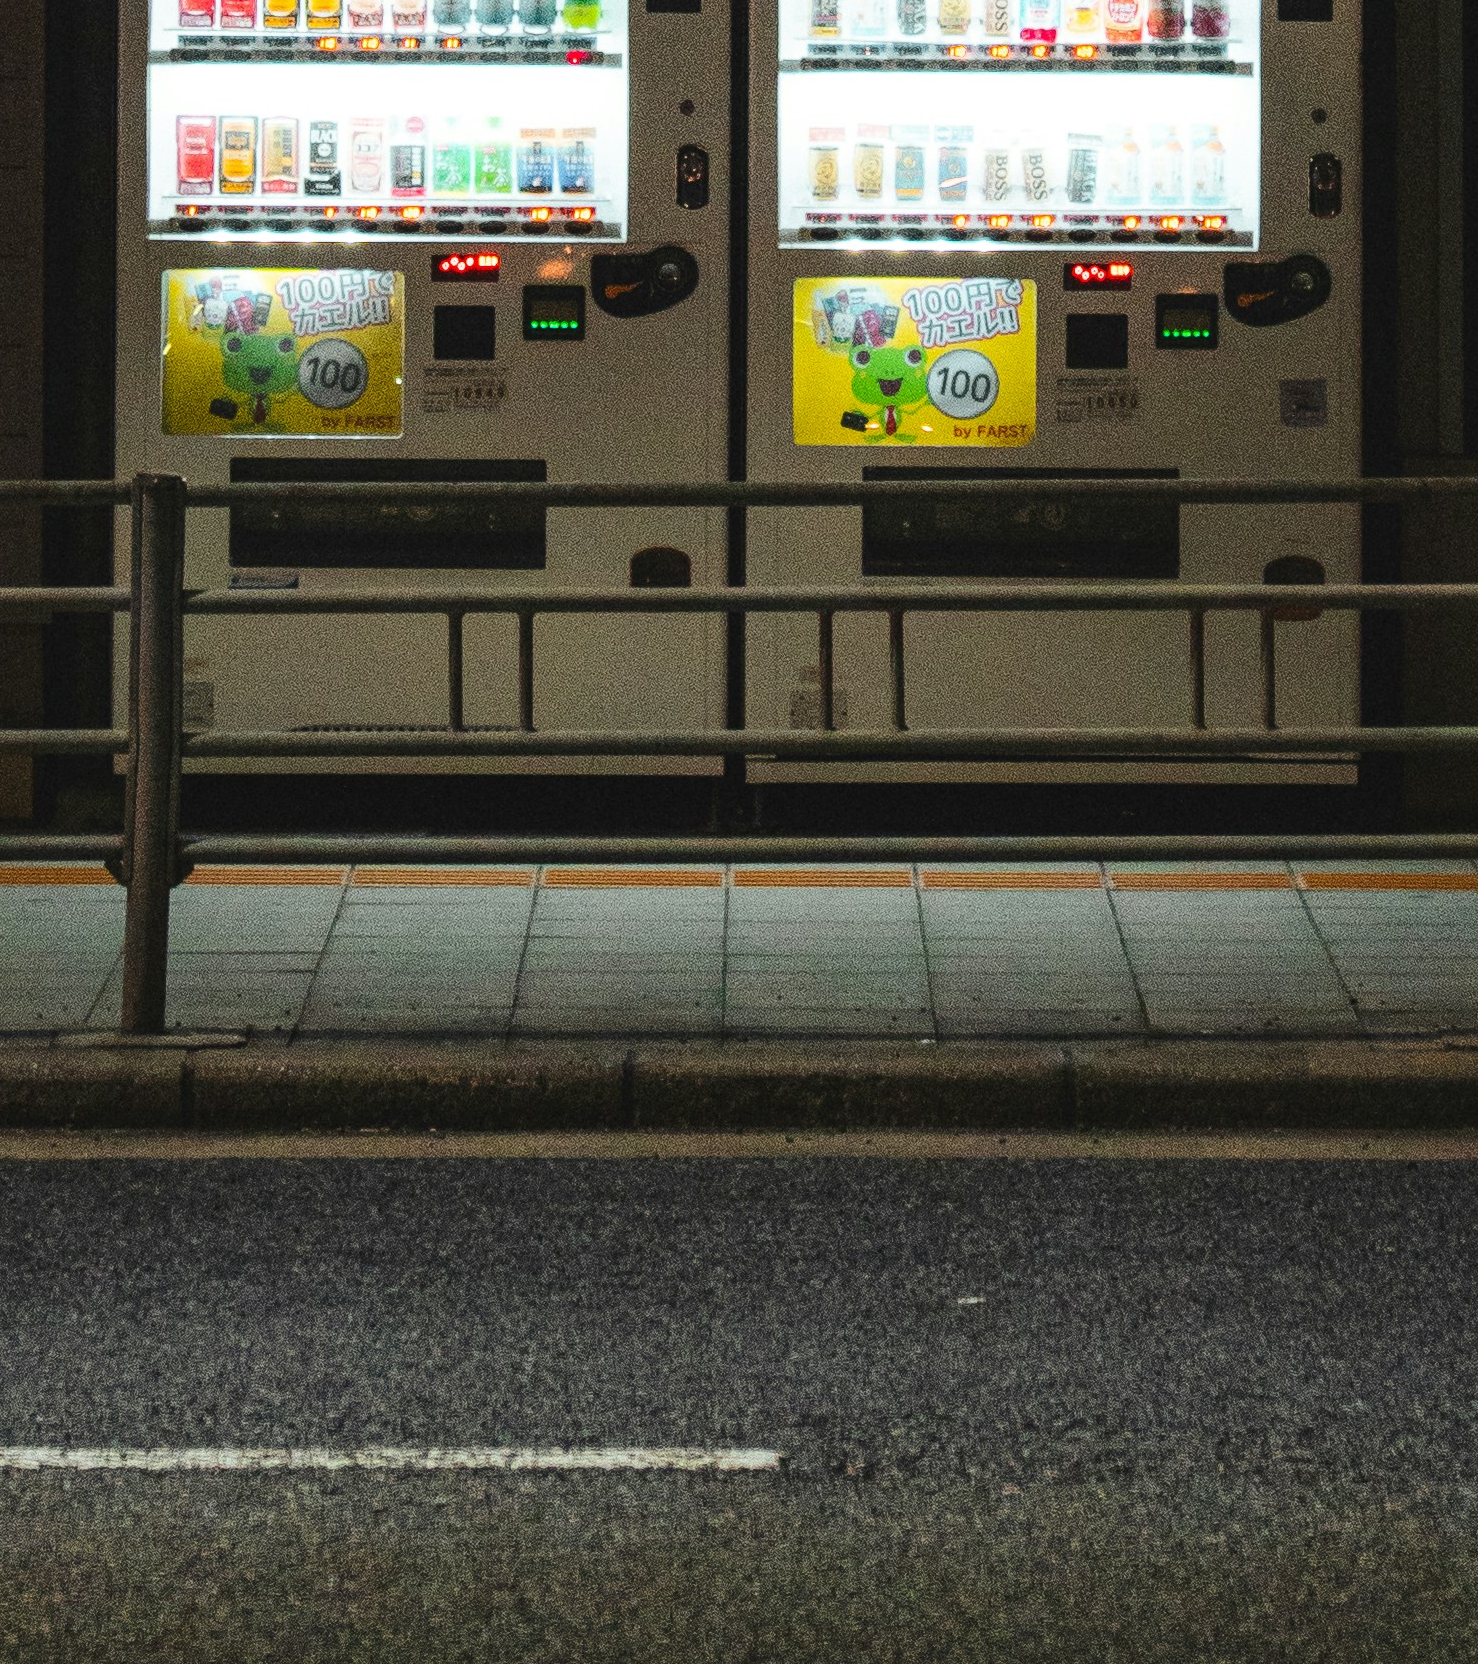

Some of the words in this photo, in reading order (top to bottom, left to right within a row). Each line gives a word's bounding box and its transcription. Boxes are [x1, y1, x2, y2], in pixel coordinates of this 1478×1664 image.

[310, 129, 338, 143] BLACK
[995, 154, 1009, 202] BOSS
[1028, 153, 1049, 202] BOSS
[278, 270, 396, 309] 100円で
[903, 278, 1022, 317] 100円で
[306, 357, 361, 393] 100
[936, 367, 991, 403] 100
[953, 424, 972, 440] by
[977, 423, 1027, 438] FARST
